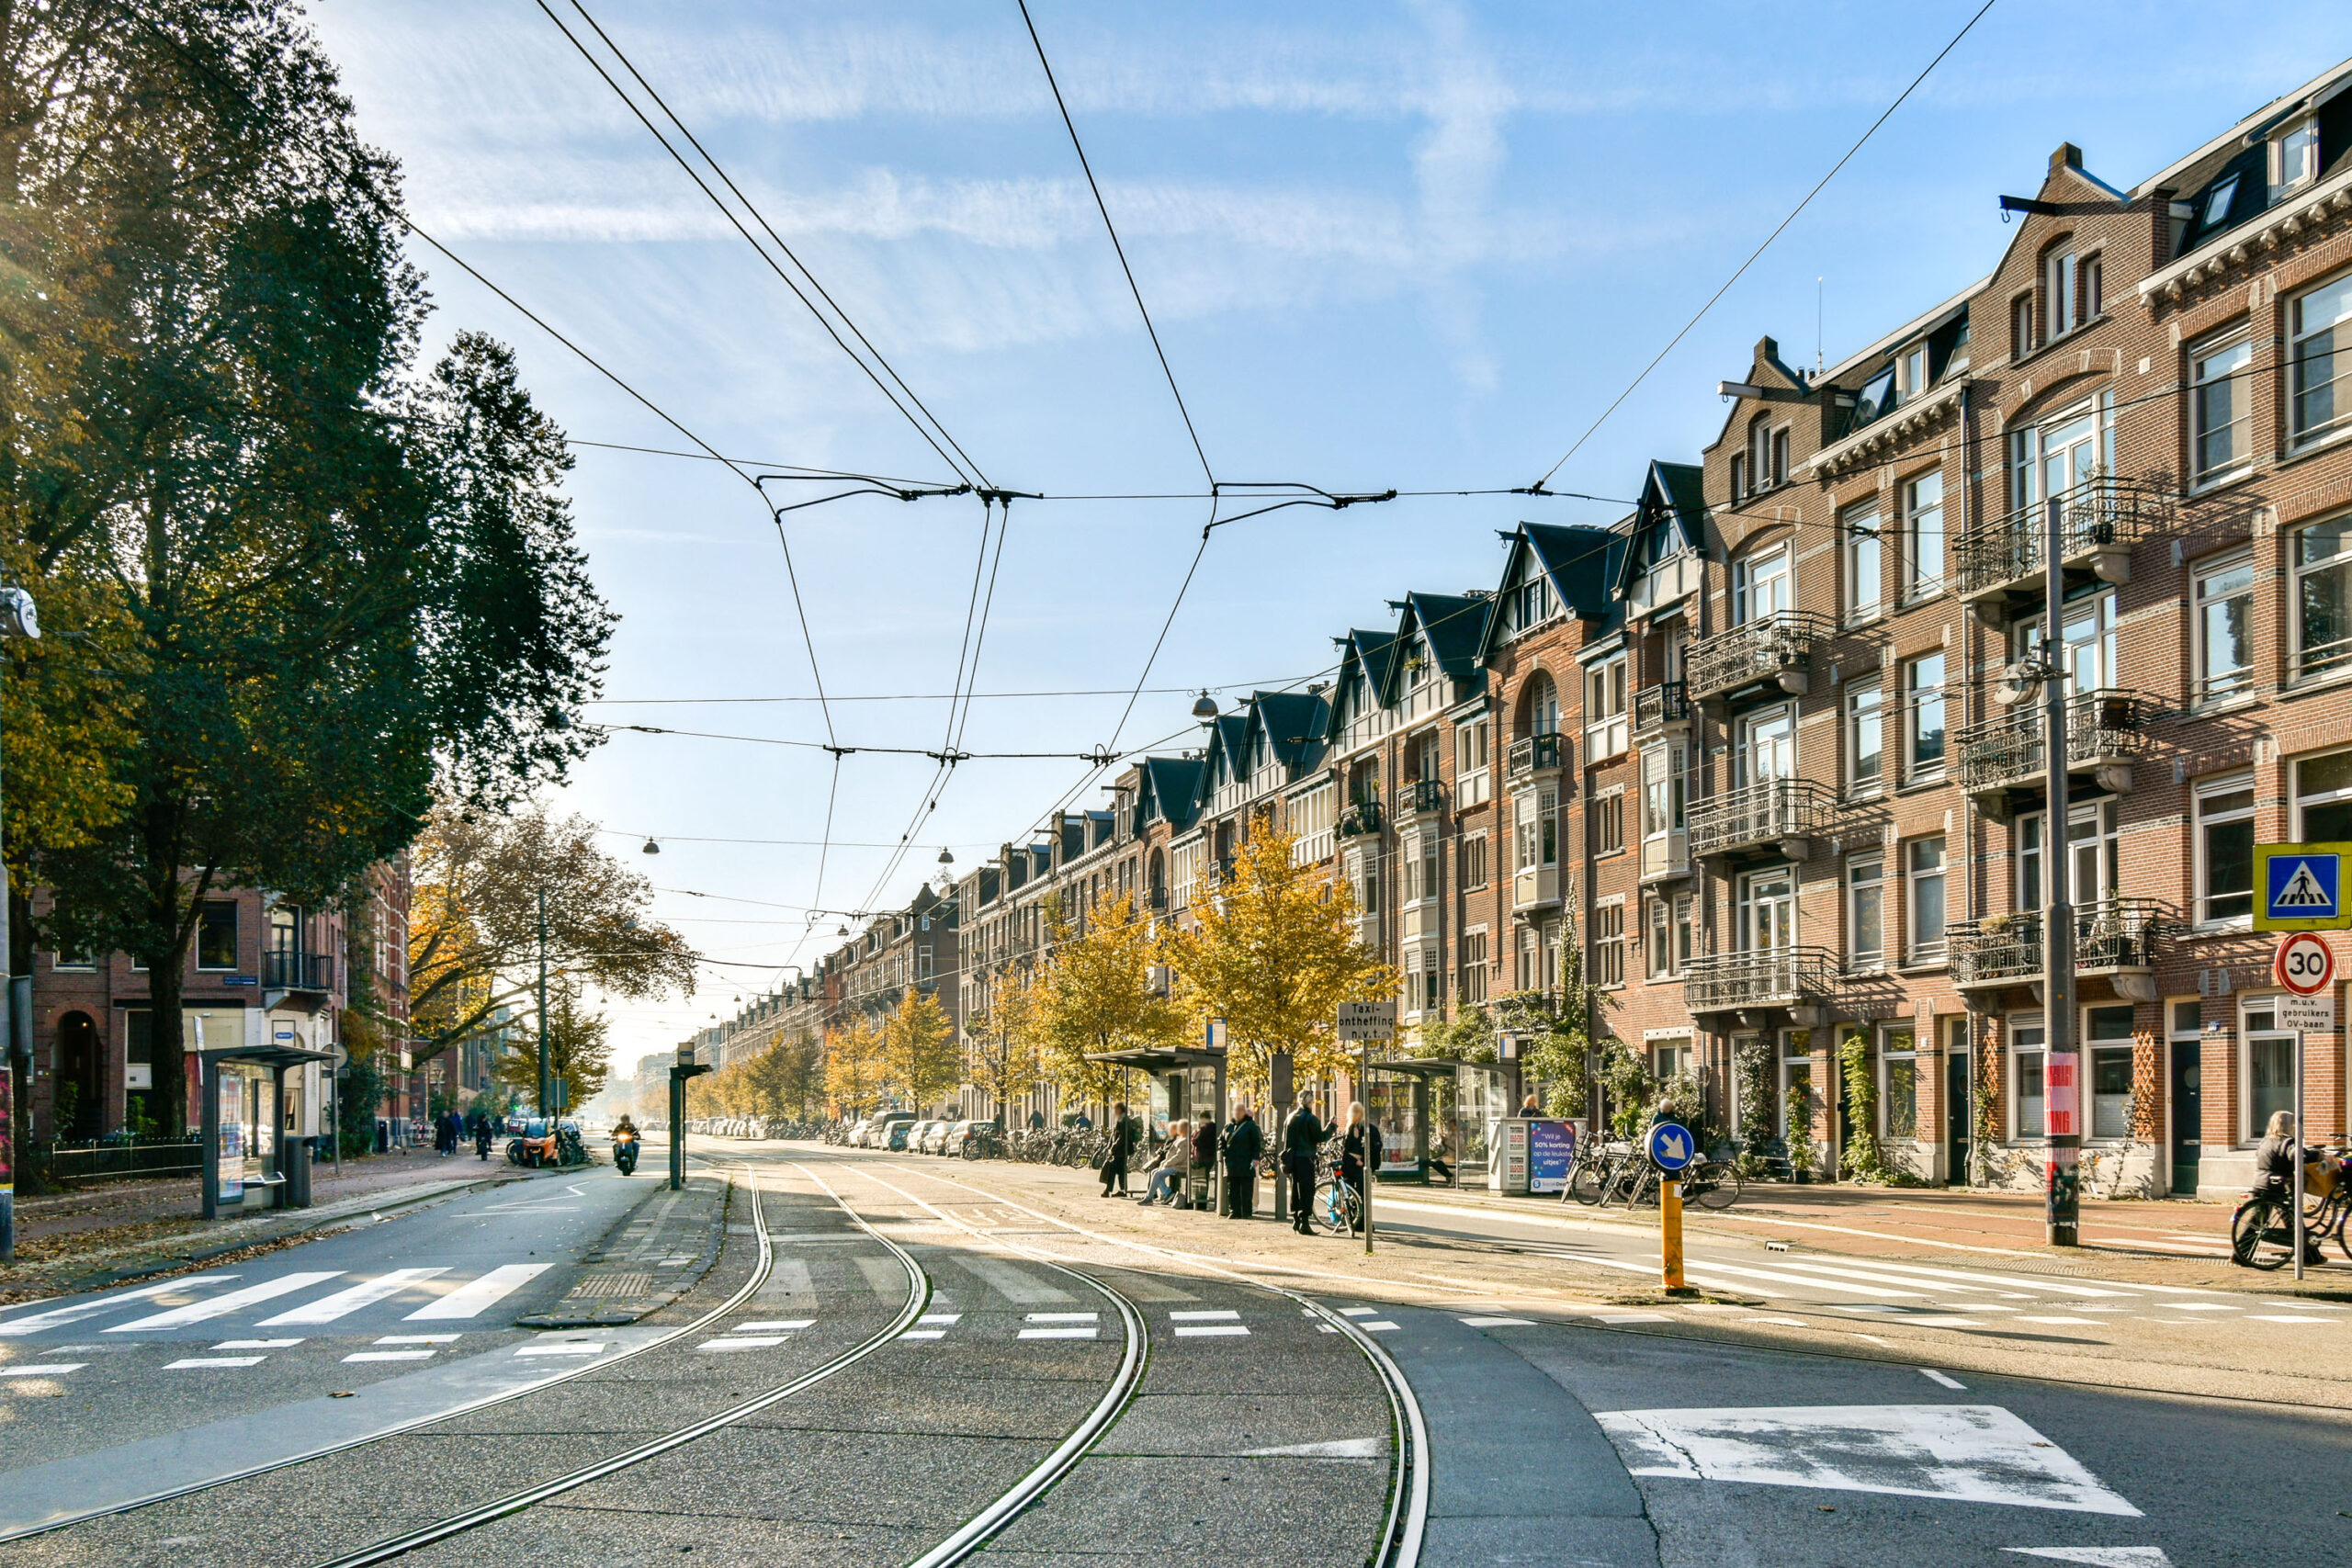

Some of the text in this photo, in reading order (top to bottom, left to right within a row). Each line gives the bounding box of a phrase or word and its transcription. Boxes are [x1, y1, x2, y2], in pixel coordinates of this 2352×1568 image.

[2289, 952, 2324, 976] 30
[1351, 1003, 1381, 1013] Taxi-
[2282, 1010, 2330, 1019] gebruikers
[1339, 1016, 1394, 1029] ontheffing
[2287, 1020, 2324, 1028] OV-baan
[1351, 1030, 1381, 1039] n.v.t.
[1370, 1096, 1410, 1108] SMAK
